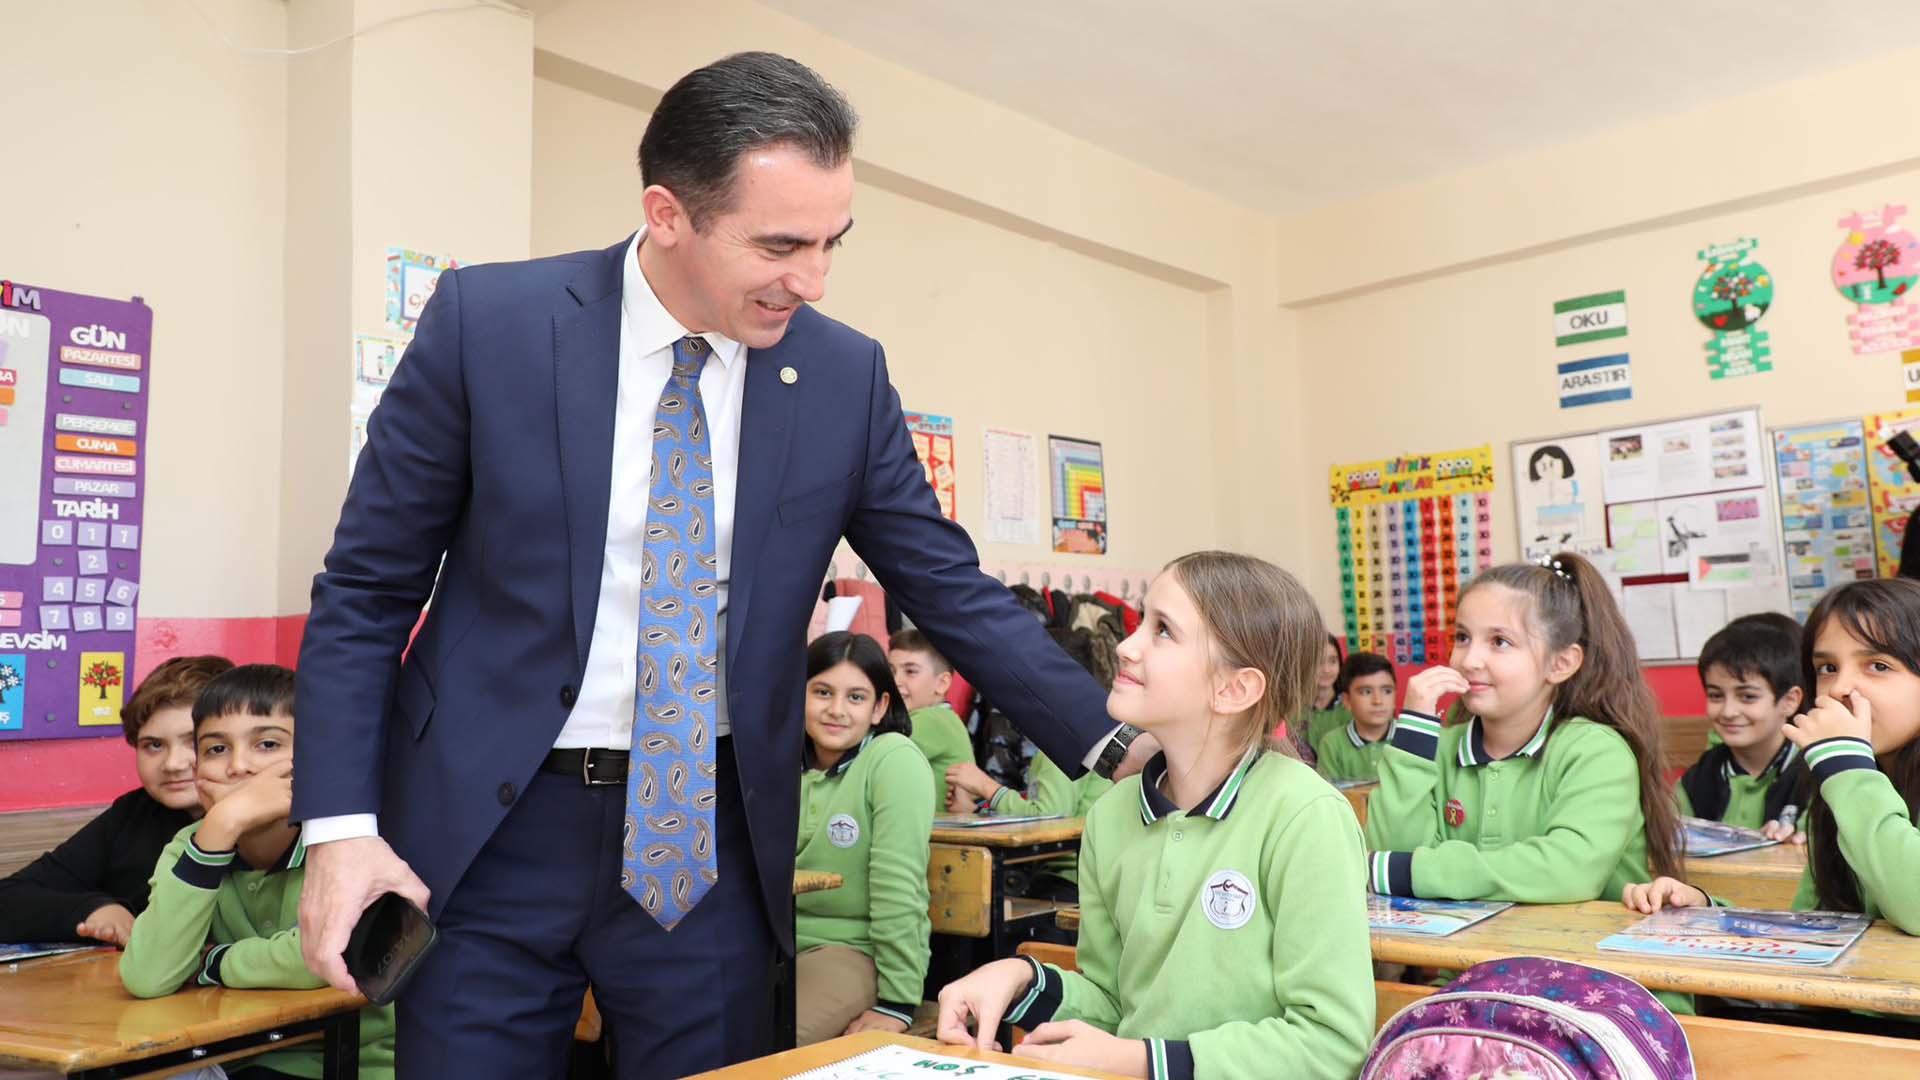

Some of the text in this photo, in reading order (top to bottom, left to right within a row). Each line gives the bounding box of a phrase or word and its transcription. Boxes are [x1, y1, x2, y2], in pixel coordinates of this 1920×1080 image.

[1570, 310, 1608, 329] OKU
[70, 324, 126, 350] GÜN
[76, 438, 119, 453] CUMA
[74, 480, 120, 495] PAZAR
[52, 498, 119, 521] TARİH
[52, 526, 64, 539] 0
[88, 555, 99, 569] 2
[52, 582, 65, 596] 4
[85, 583, 96, 597] 5
[117, 585, 130, 600] 6
[49, 610, 60, 624] 7
[83, 611, 95, 625] 8
[115, 612, 127, 625] 9
